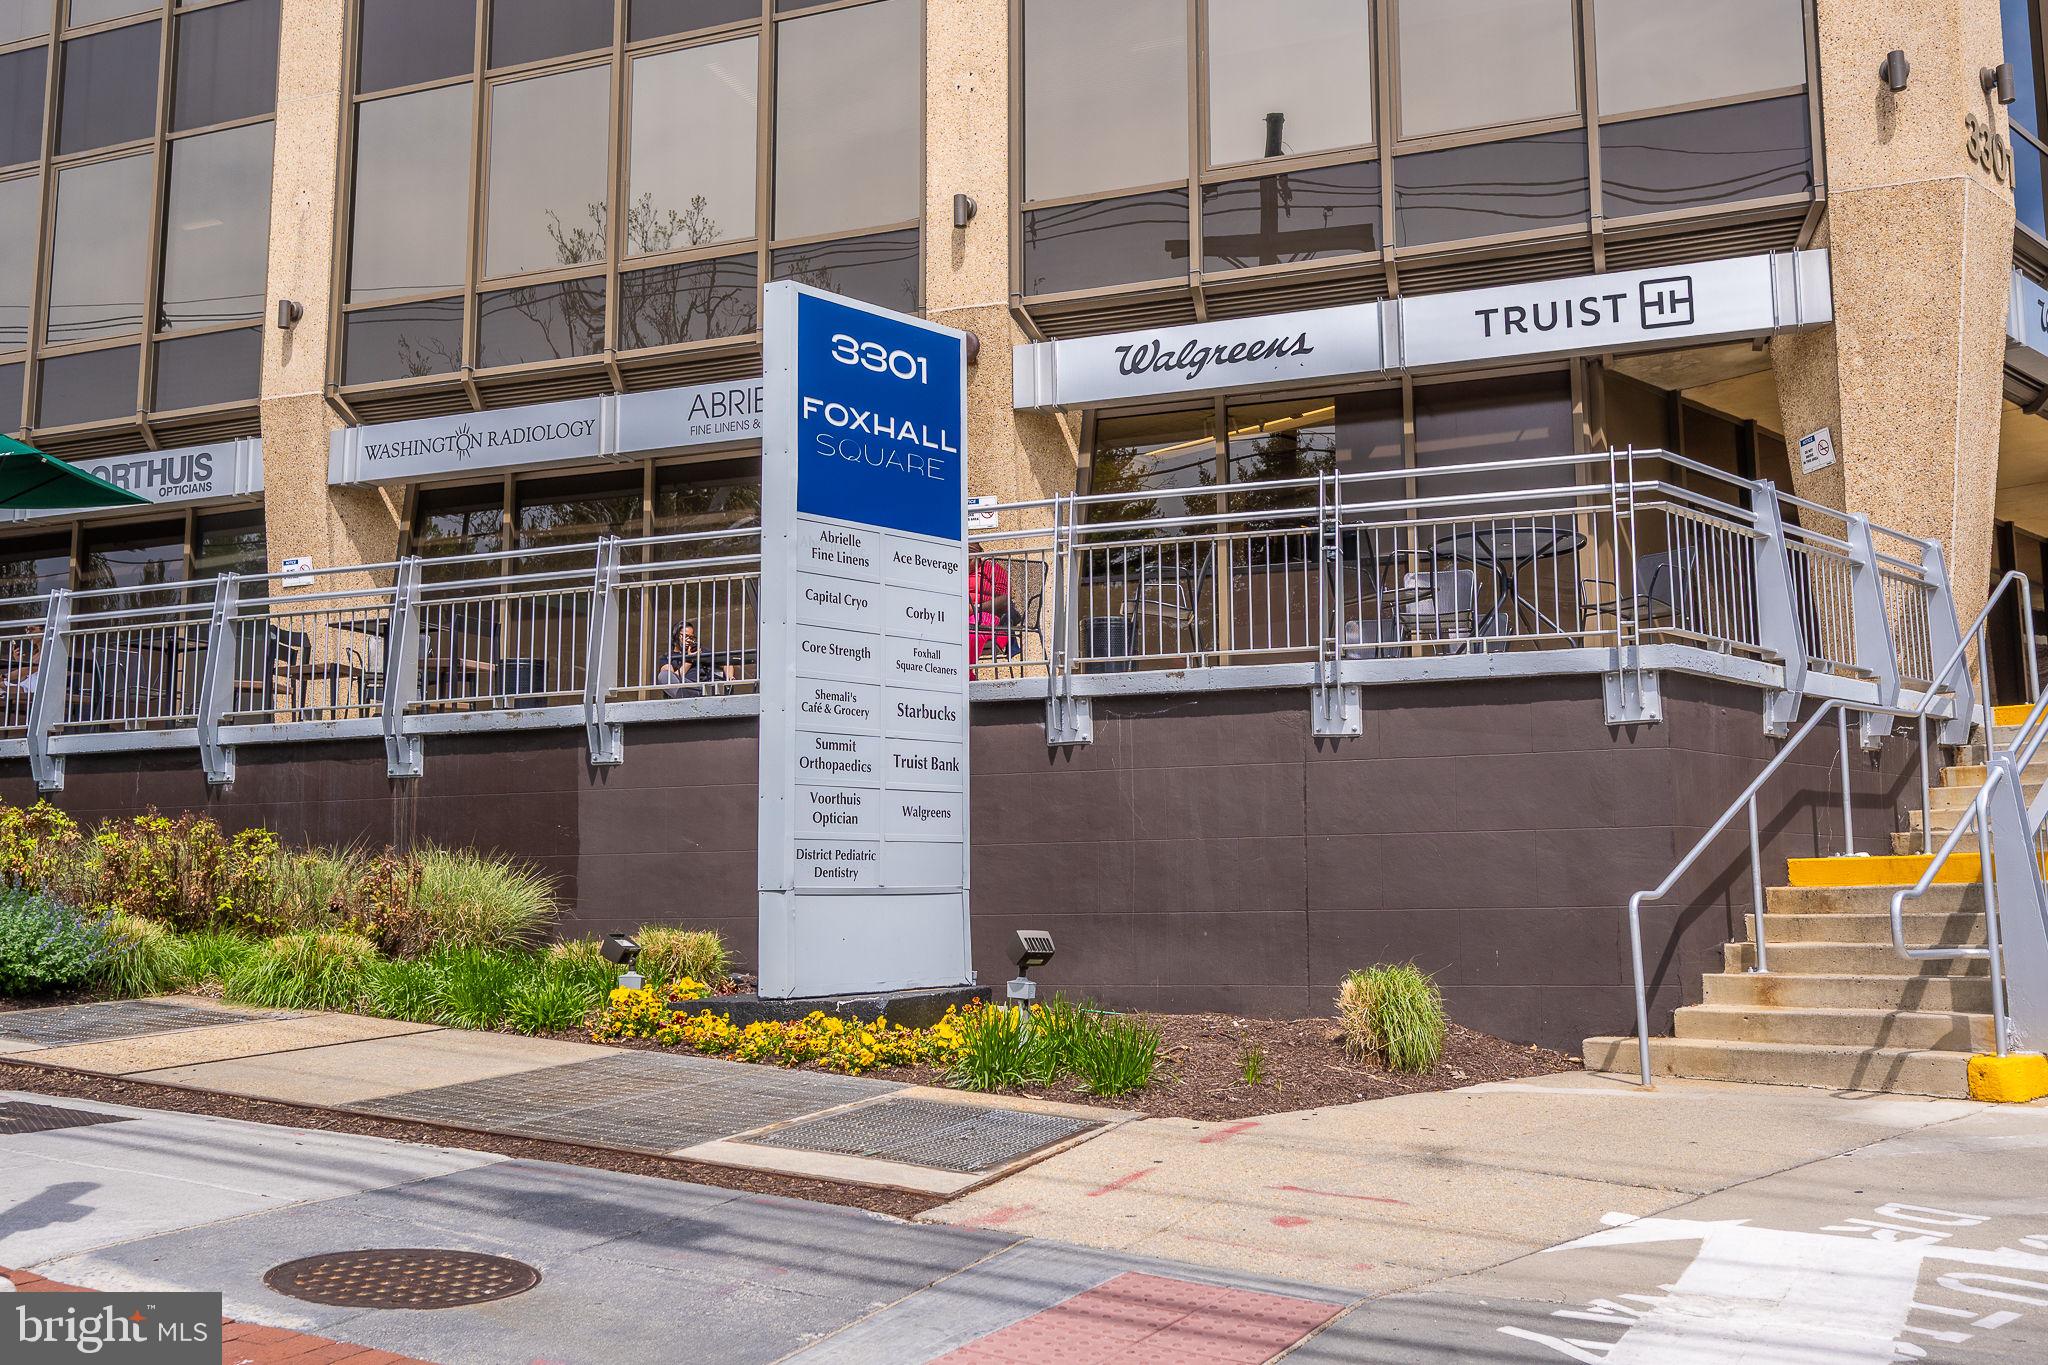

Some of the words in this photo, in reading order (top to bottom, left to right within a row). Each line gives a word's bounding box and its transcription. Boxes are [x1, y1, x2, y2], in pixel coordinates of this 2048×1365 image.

[1965, 112, 2016, 189] 3301
[1474, 293, 1628, 338] TRUIST
[831, 334, 928, 384] 3301
[1115, 332, 1315, 381] Walgreens
[691, 423, 712, 436] FINE
[715, 420, 750, 434] LINENS
[803, 396, 957, 454] FOXHALL
[365, 430, 483, 461] WASHINGTON
[488, 419, 596, 447] RADIOLOGY
[816, 433, 945, 481] SQUARE
[88, 453, 213, 490] ORTHUIS
[159, 482, 212, 497] OPTICIANS
[820, 530, 861, 548] Abrielle
[812, 547, 834, 562] Fine
[837, 551, 870, 567] Linens
[893, 551, 912, 564] Ace
[915, 553, 959, 574] Beverage
[805, 588, 841, 605] Capital
[844, 594, 868, 610] Cryo
[906, 606, 935, 624] Corby
[802, 640, 827, 654] Core
[829, 643, 871, 661] Strength
[913, 648, 941, 660] Foxhall
[896, 660, 923, 672] Square
[924, 663, 957, 676] Cleaners
[815, 689, 857, 703] Shemali's
[802, 701, 822, 714] Café
[824, 704, 832, 714] &
[834, 705, 869, 720] Grocery
[897, 703, 956, 722] Starbucks
[815, 737, 856, 752] Summit
[800, 756, 872, 774] Orthopaedics
[893, 754, 928, 770] Truist
[931, 756, 959, 772] Bank
[810, 792, 861, 805] Voorthuis
[812, 811, 858, 827] Optician
[902, 805, 951, 821] Walgreens
[796, 849, 832, 860] District
[835, 850, 876, 861] Pediatric
[814, 866, 859, 881] Dentistry
